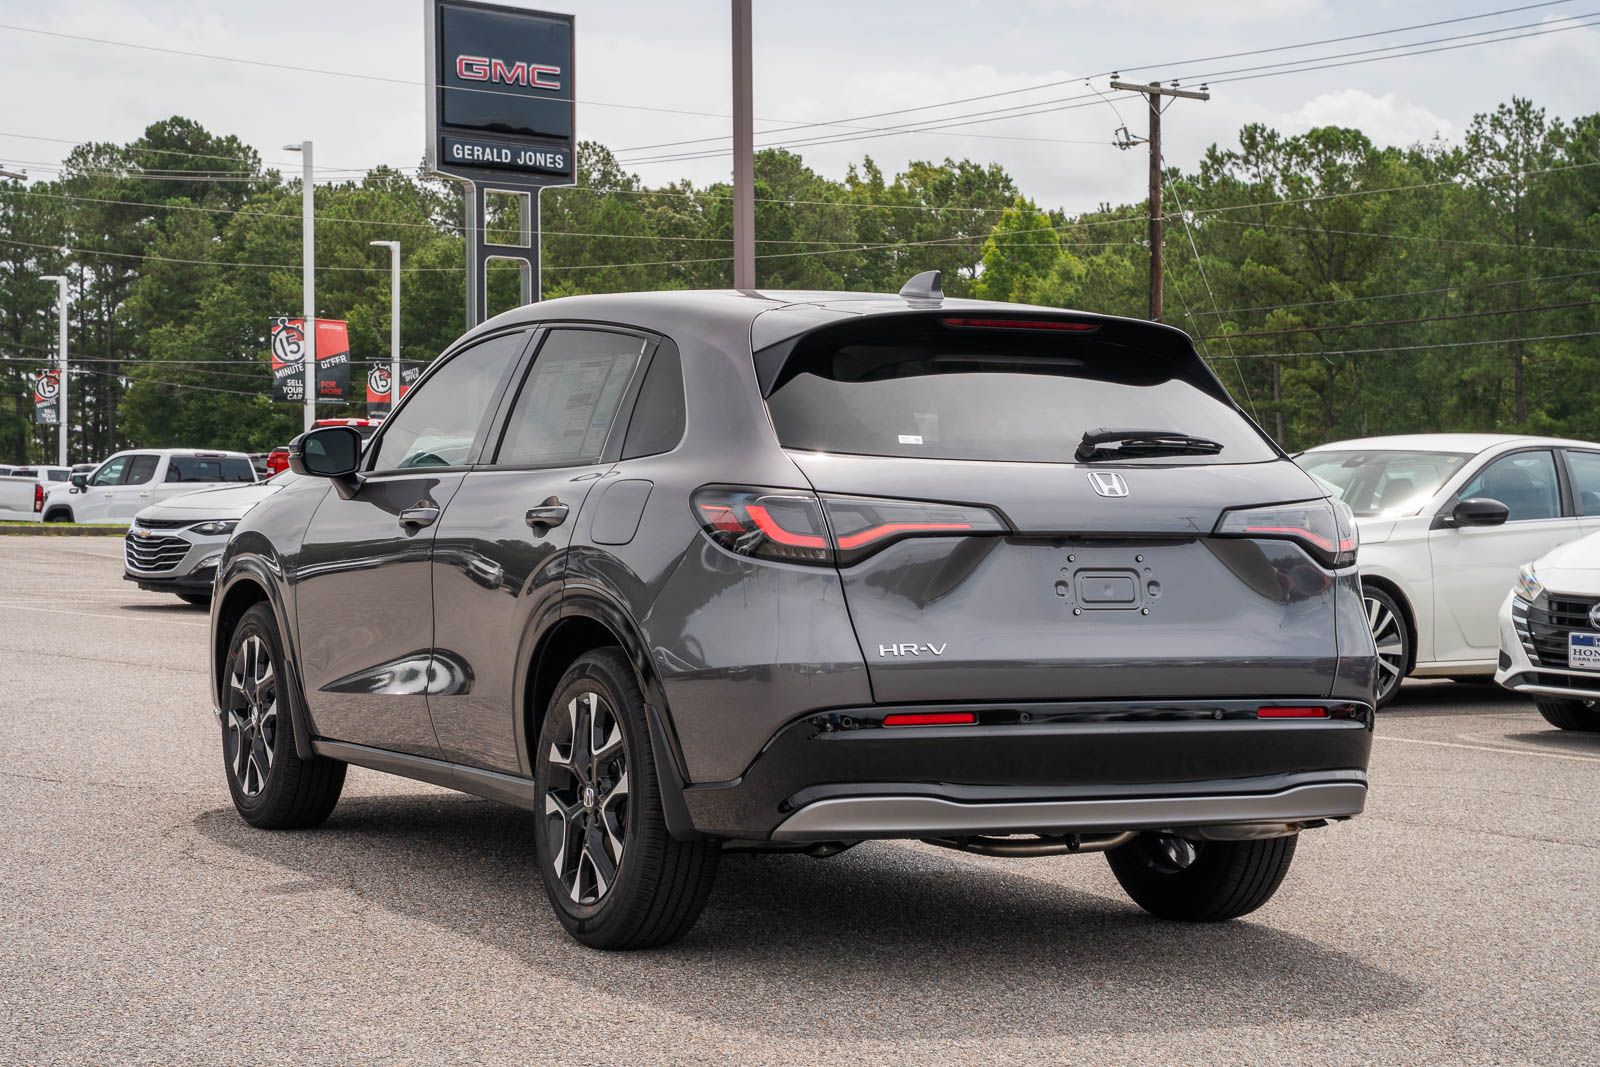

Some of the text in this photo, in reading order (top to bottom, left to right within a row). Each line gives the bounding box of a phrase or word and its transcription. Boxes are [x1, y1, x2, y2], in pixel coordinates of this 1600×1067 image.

[456, 54, 561, 89] GMC
[453, 143, 564, 169] GERALD JONES
[279, 333, 301, 357] 15
[320, 354, 348, 369] OFFER
[274, 363, 304, 379] MINUTE
[41, 381, 56, 395] 15
[319, 380, 337, 388] FOR
[373, 373, 389, 390] 15
[282, 386, 304, 394] YOUR
[319, 388, 343, 396] MORE
[878, 642, 947, 657] HR-V
